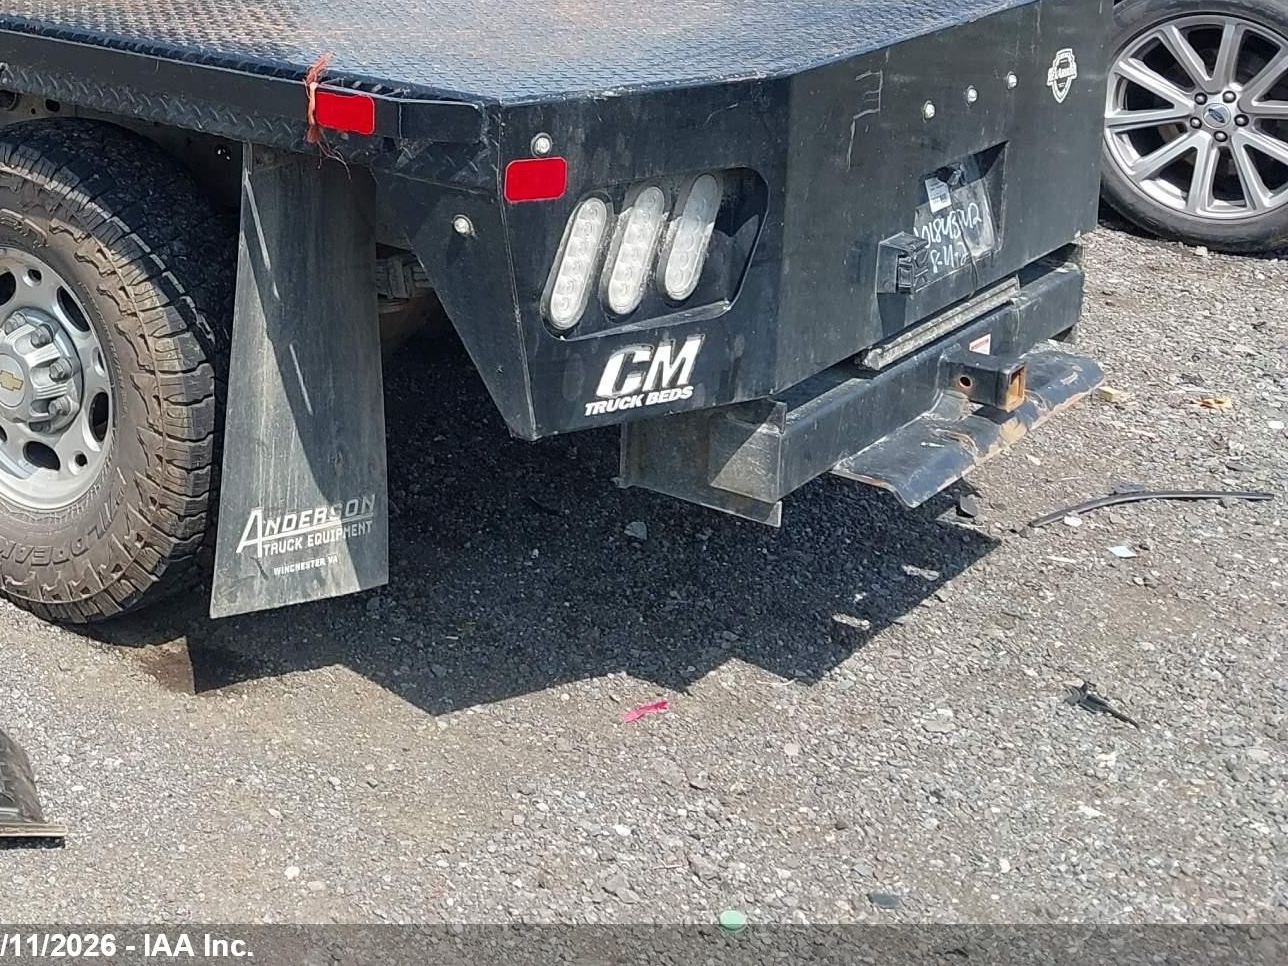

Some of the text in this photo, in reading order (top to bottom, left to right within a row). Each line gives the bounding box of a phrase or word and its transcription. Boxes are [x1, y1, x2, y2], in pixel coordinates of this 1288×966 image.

[595, 333, 705, 398] CM
[584, 385, 695, 417] TRUCK BEDS
[235, 493, 376, 557] ANDERSON
[263, 520, 373, 557] TRUCK EQUIPMENT
[273, 557, 326, 575] WINCHESTER
